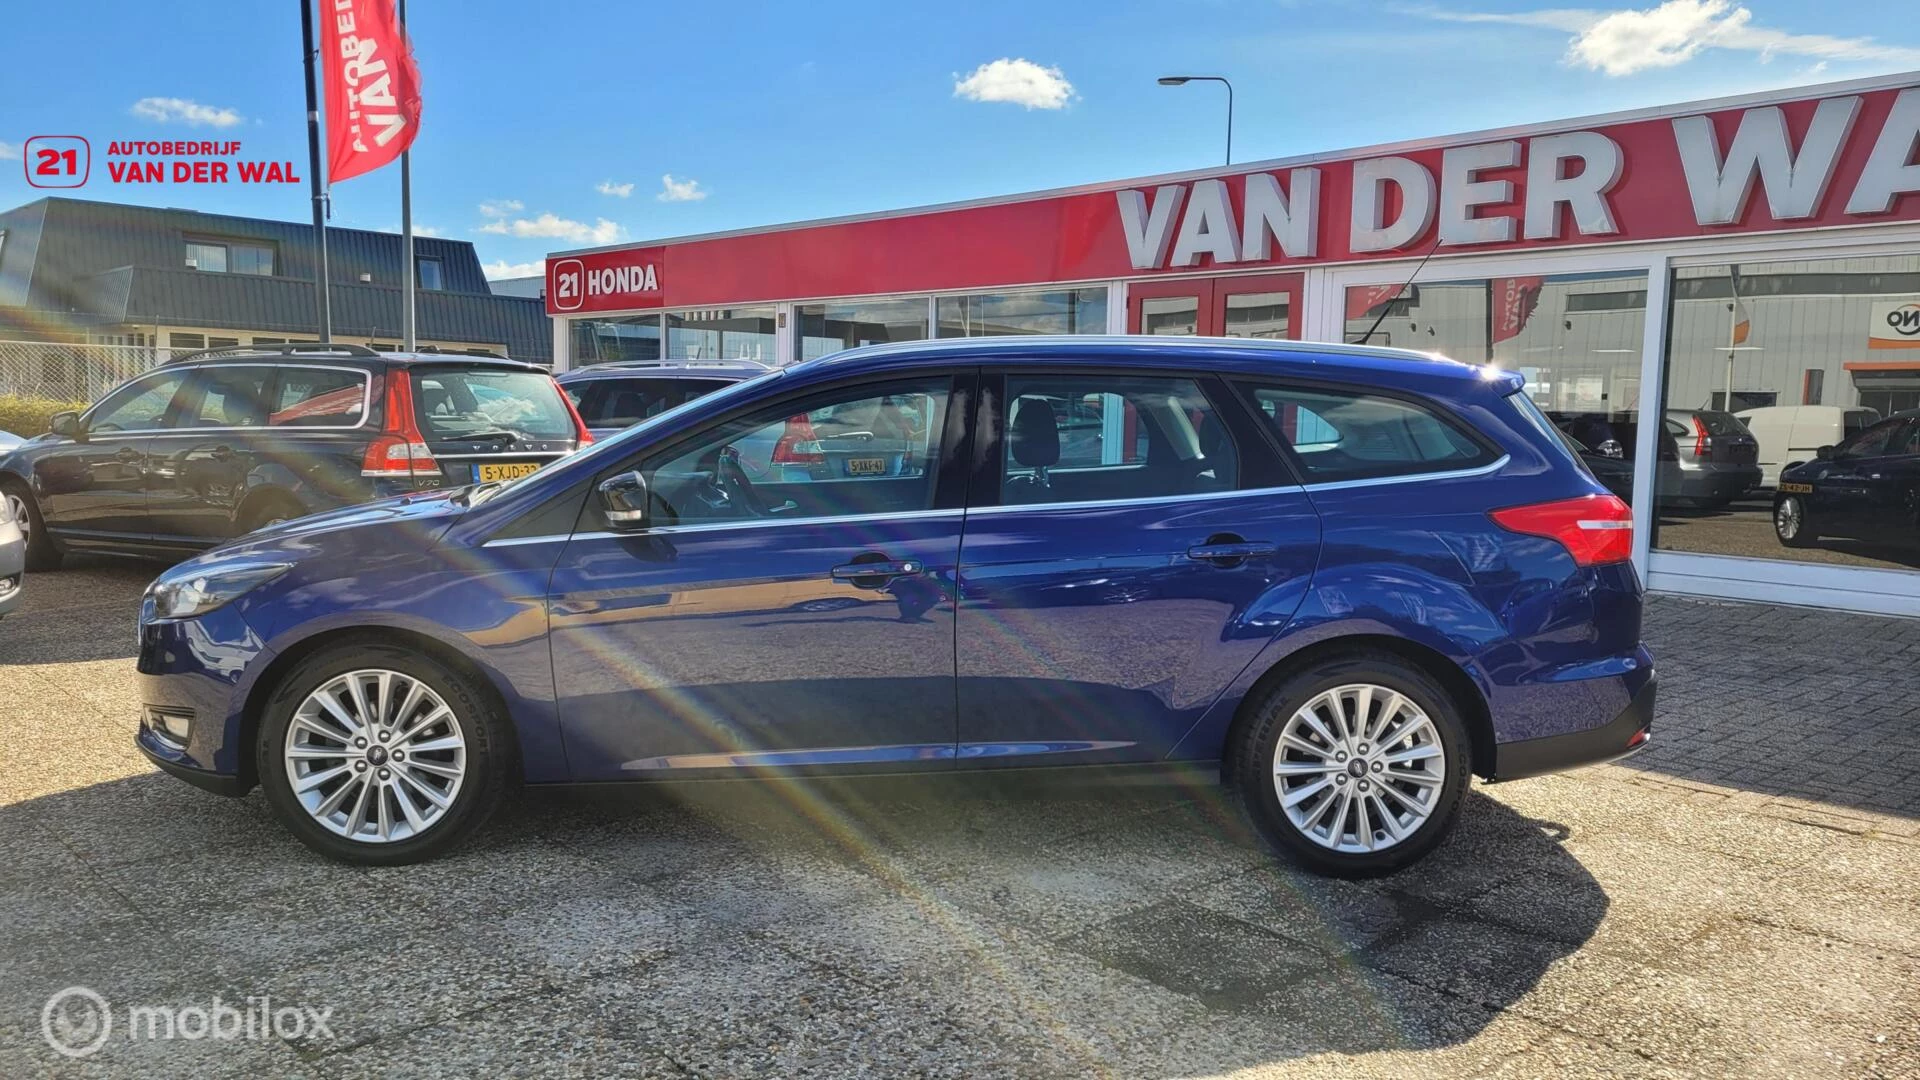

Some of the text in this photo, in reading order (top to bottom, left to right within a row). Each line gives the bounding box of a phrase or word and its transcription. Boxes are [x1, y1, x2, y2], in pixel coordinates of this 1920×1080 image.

[358, 38, 407, 147] VAN
[1116, 166, 1321, 269] VAN
[1350, 131, 1624, 253] DER
[558, 264, 659, 298] 21 HONDA
